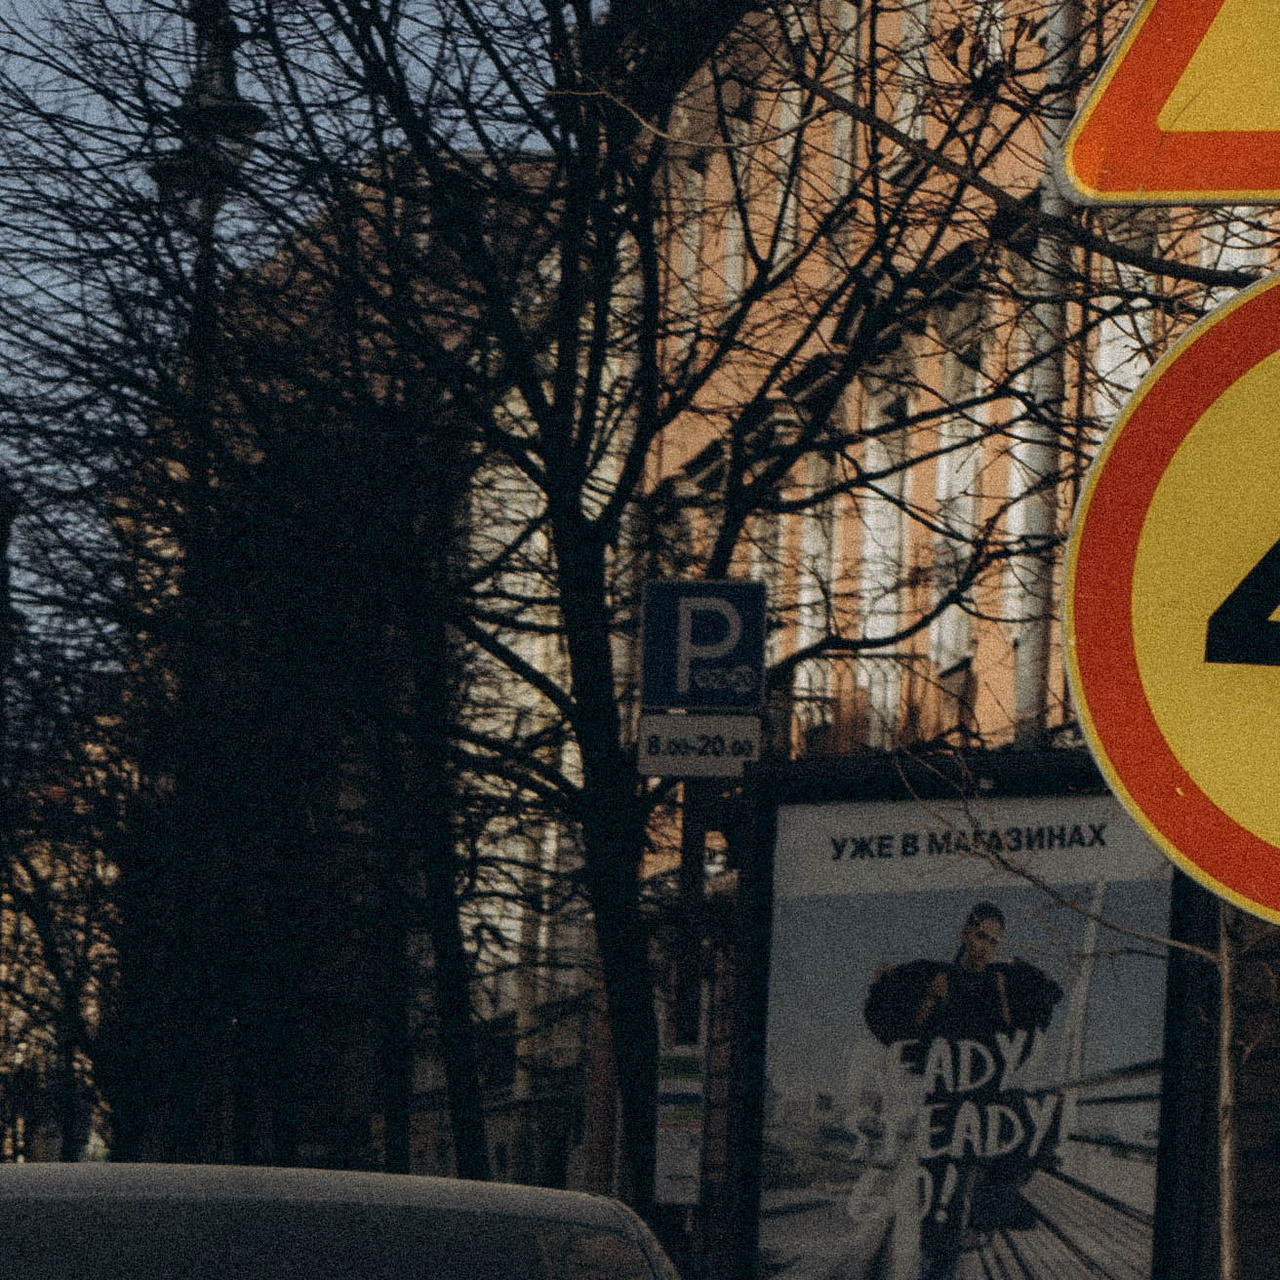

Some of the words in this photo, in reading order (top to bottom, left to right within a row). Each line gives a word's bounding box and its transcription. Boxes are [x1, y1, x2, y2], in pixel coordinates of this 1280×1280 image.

[676, 595, 743, 694] P
[830, 834, 893, 860] УЖЕ
[900, 832, 919, 857] В
[926, 823, 1108, 856] МАГАЗИНАХ
